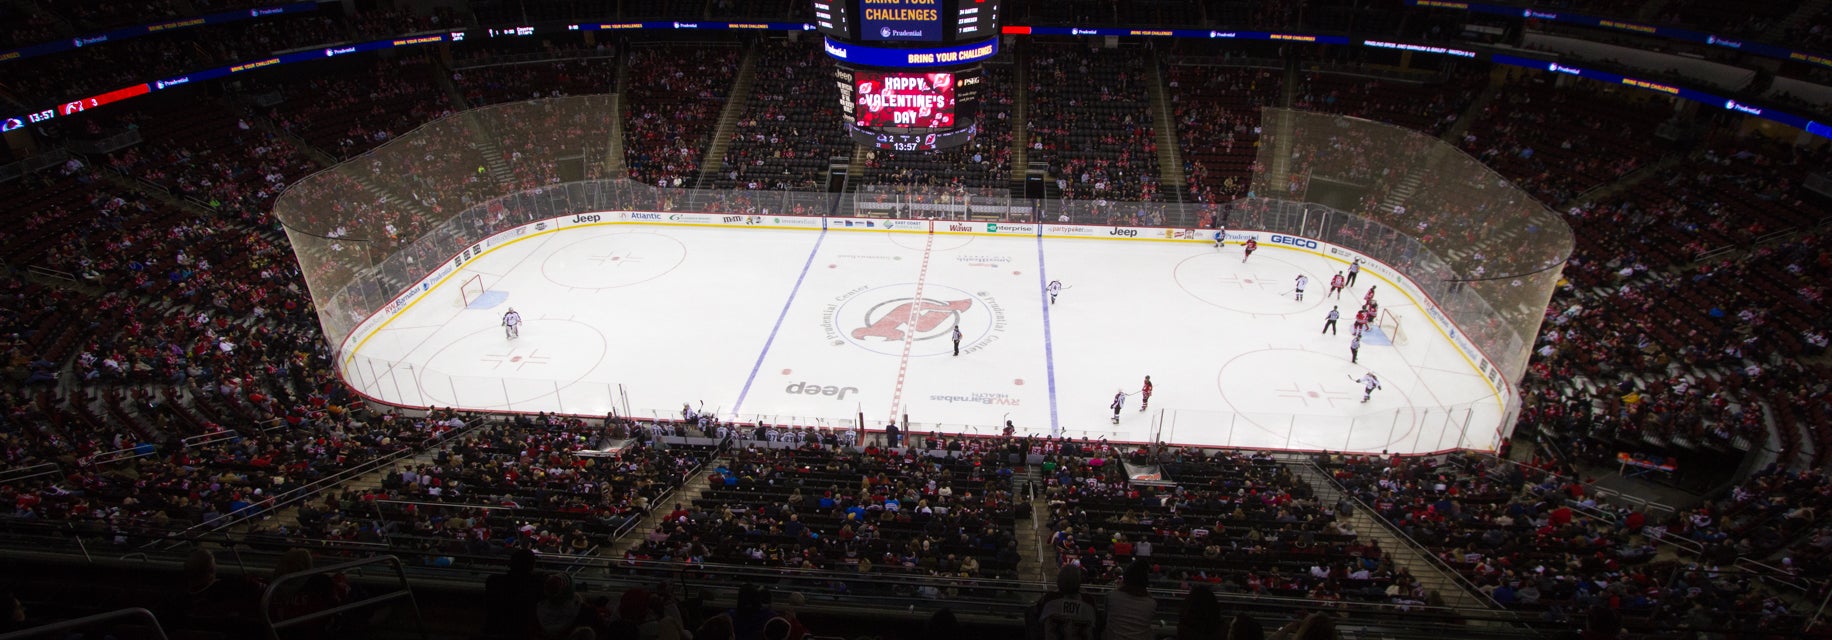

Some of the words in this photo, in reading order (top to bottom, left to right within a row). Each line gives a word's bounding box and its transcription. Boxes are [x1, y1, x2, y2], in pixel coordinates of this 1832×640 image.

[866, 9, 937, 20] CHALLENGES
[908, 54, 934, 63] BRING
[936, 52, 957, 62] YOUR
[959, 45, 992, 60] CHALLENGES
[835, 69, 852, 83] Jeep
[885, 77, 924, 90] HAPPY
[92, 98, 98, 107] 3
[865, 94, 944, 108] VALENTINE'S
[28, 109, 55, 123] 13:57
[894, 111, 917, 124] DAY
[572, 213, 601, 223] Jeep
[631, 212, 661, 220] Atlantic
[950, 222, 972, 232] Wawa
[1110, 227, 1137, 237] Jeep
[1271, 234, 1317, 250] GEICO
[835, 284, 869, 302] Center
[785, 381, 859, 400] Jeep
[1063, 601, 1081, 615] ROY
